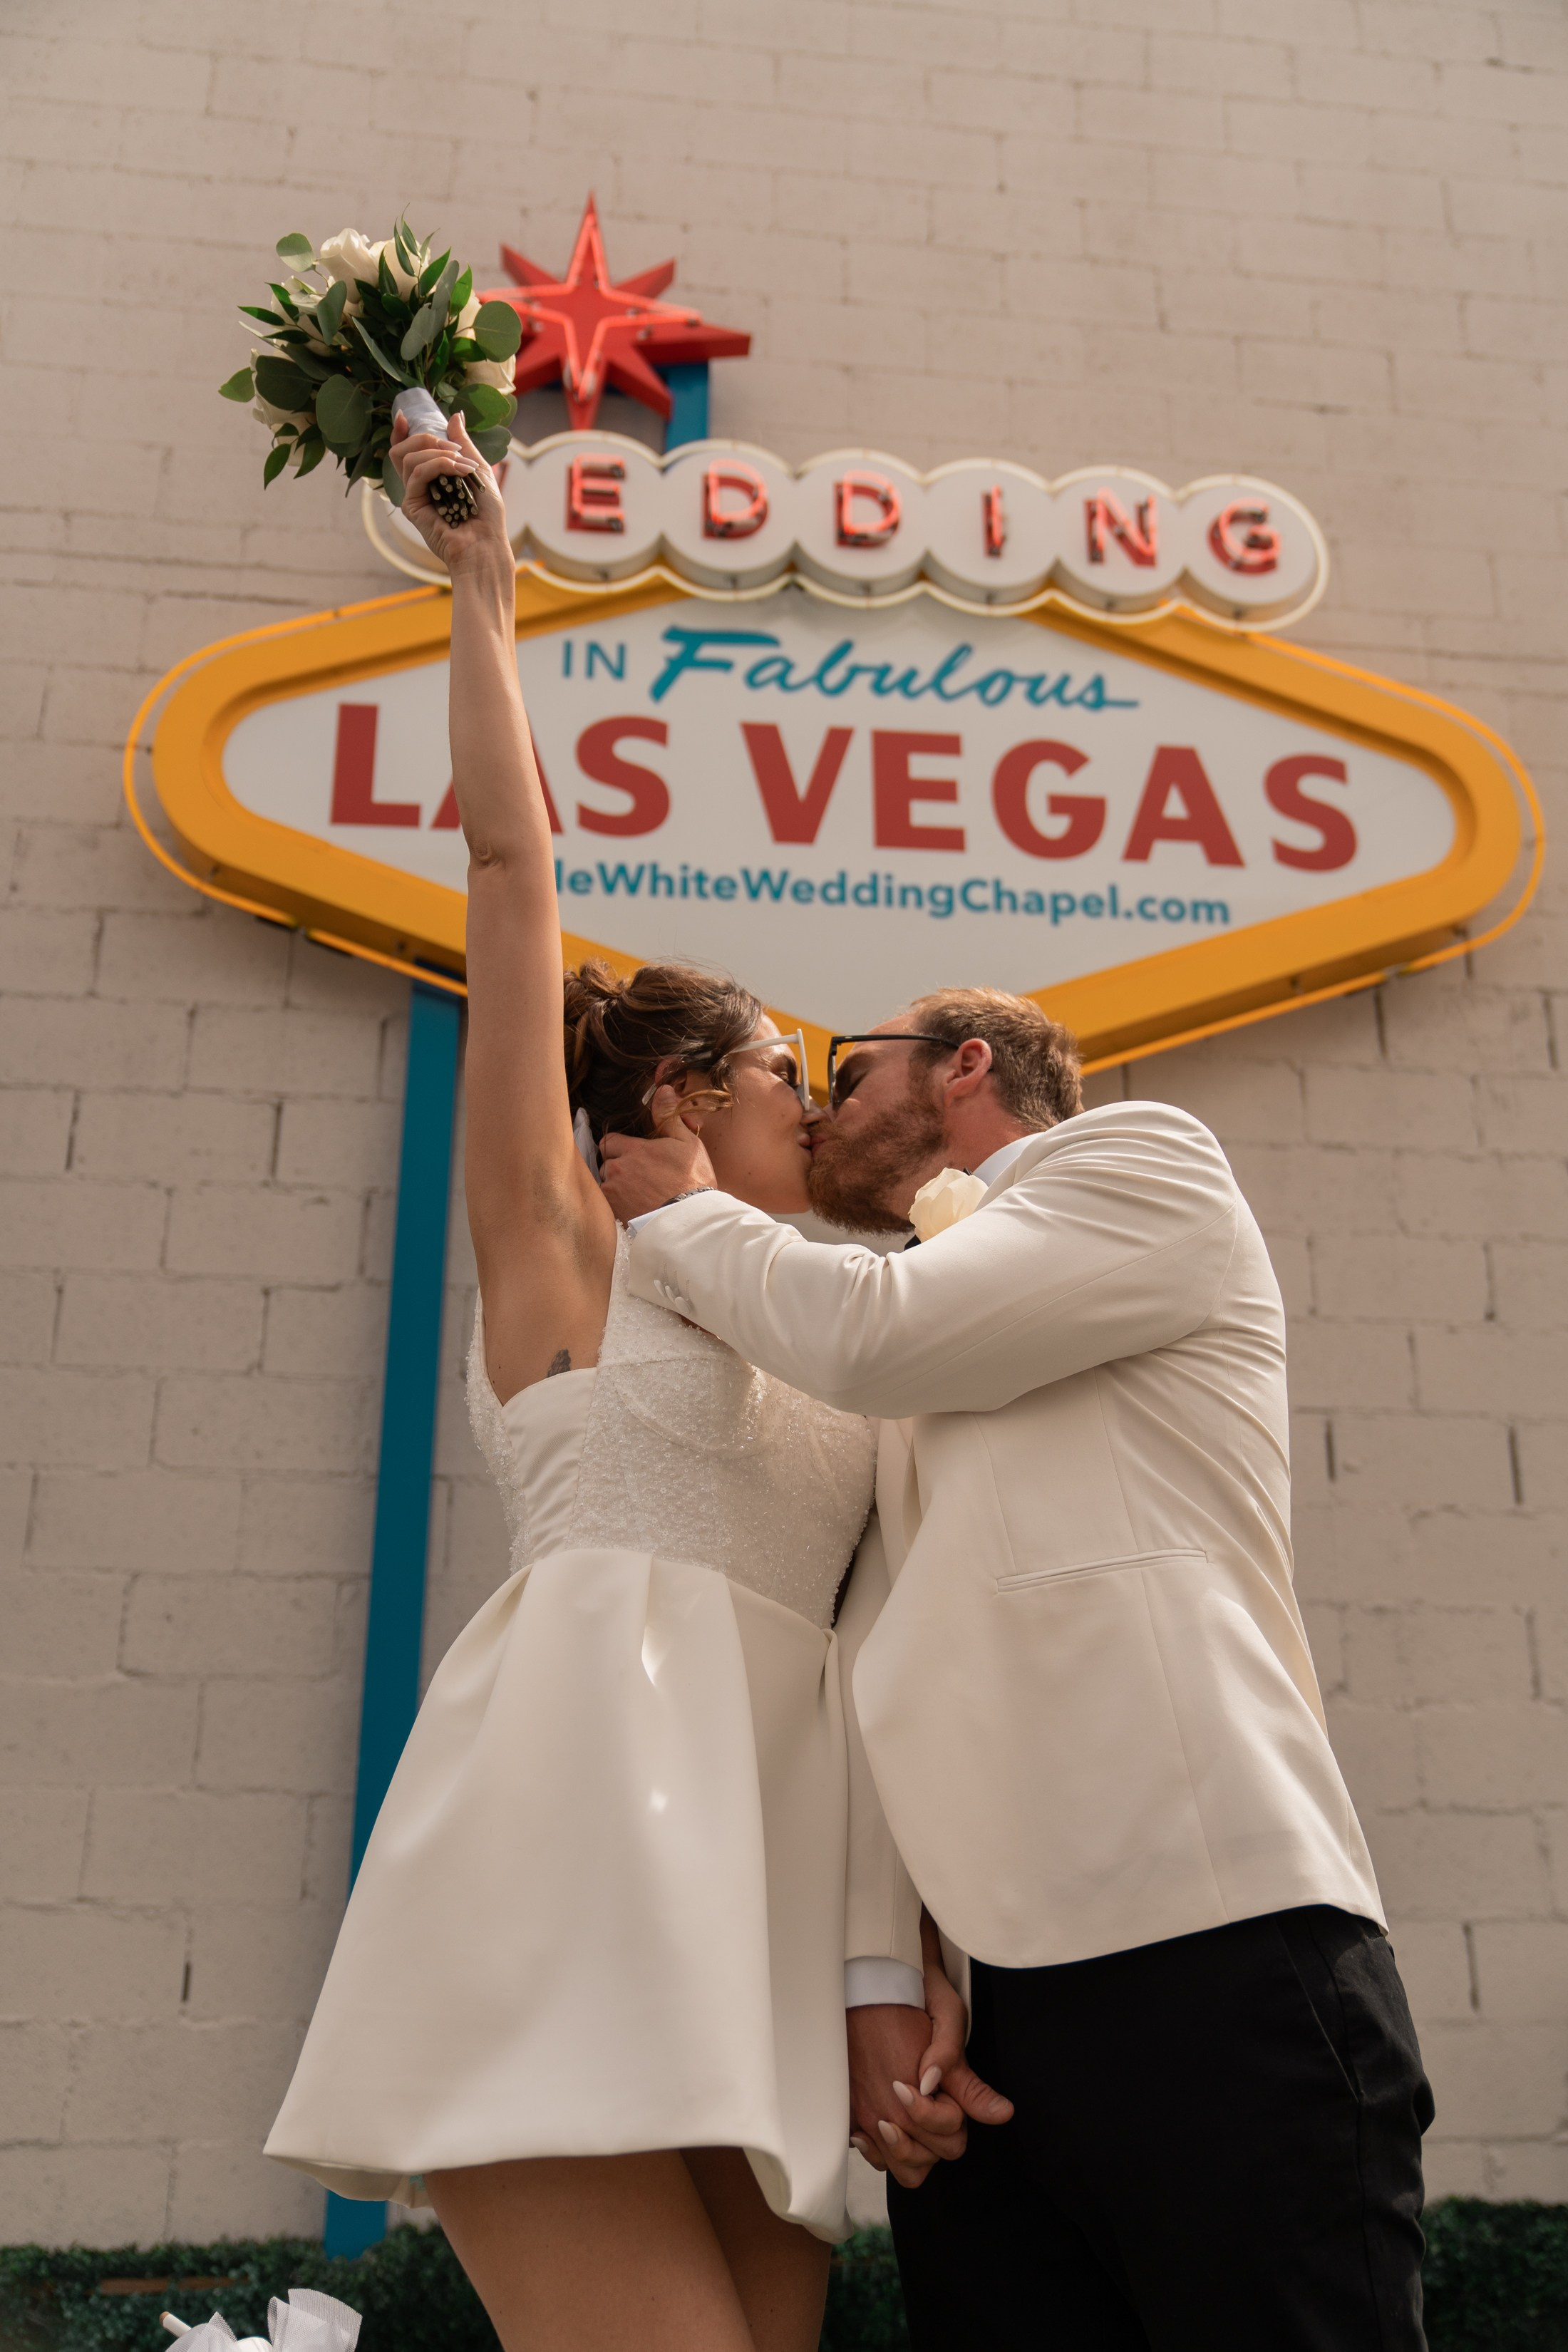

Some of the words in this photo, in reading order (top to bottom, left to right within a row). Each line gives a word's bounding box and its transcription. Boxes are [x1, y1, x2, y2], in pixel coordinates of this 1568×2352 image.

[492, 453, 1281, 574] EDDING
[562, 640, 626, 680] IN
[649, 624, 1140, 711] Fabulous
[738, 721, 1358, 873] VEGAS
